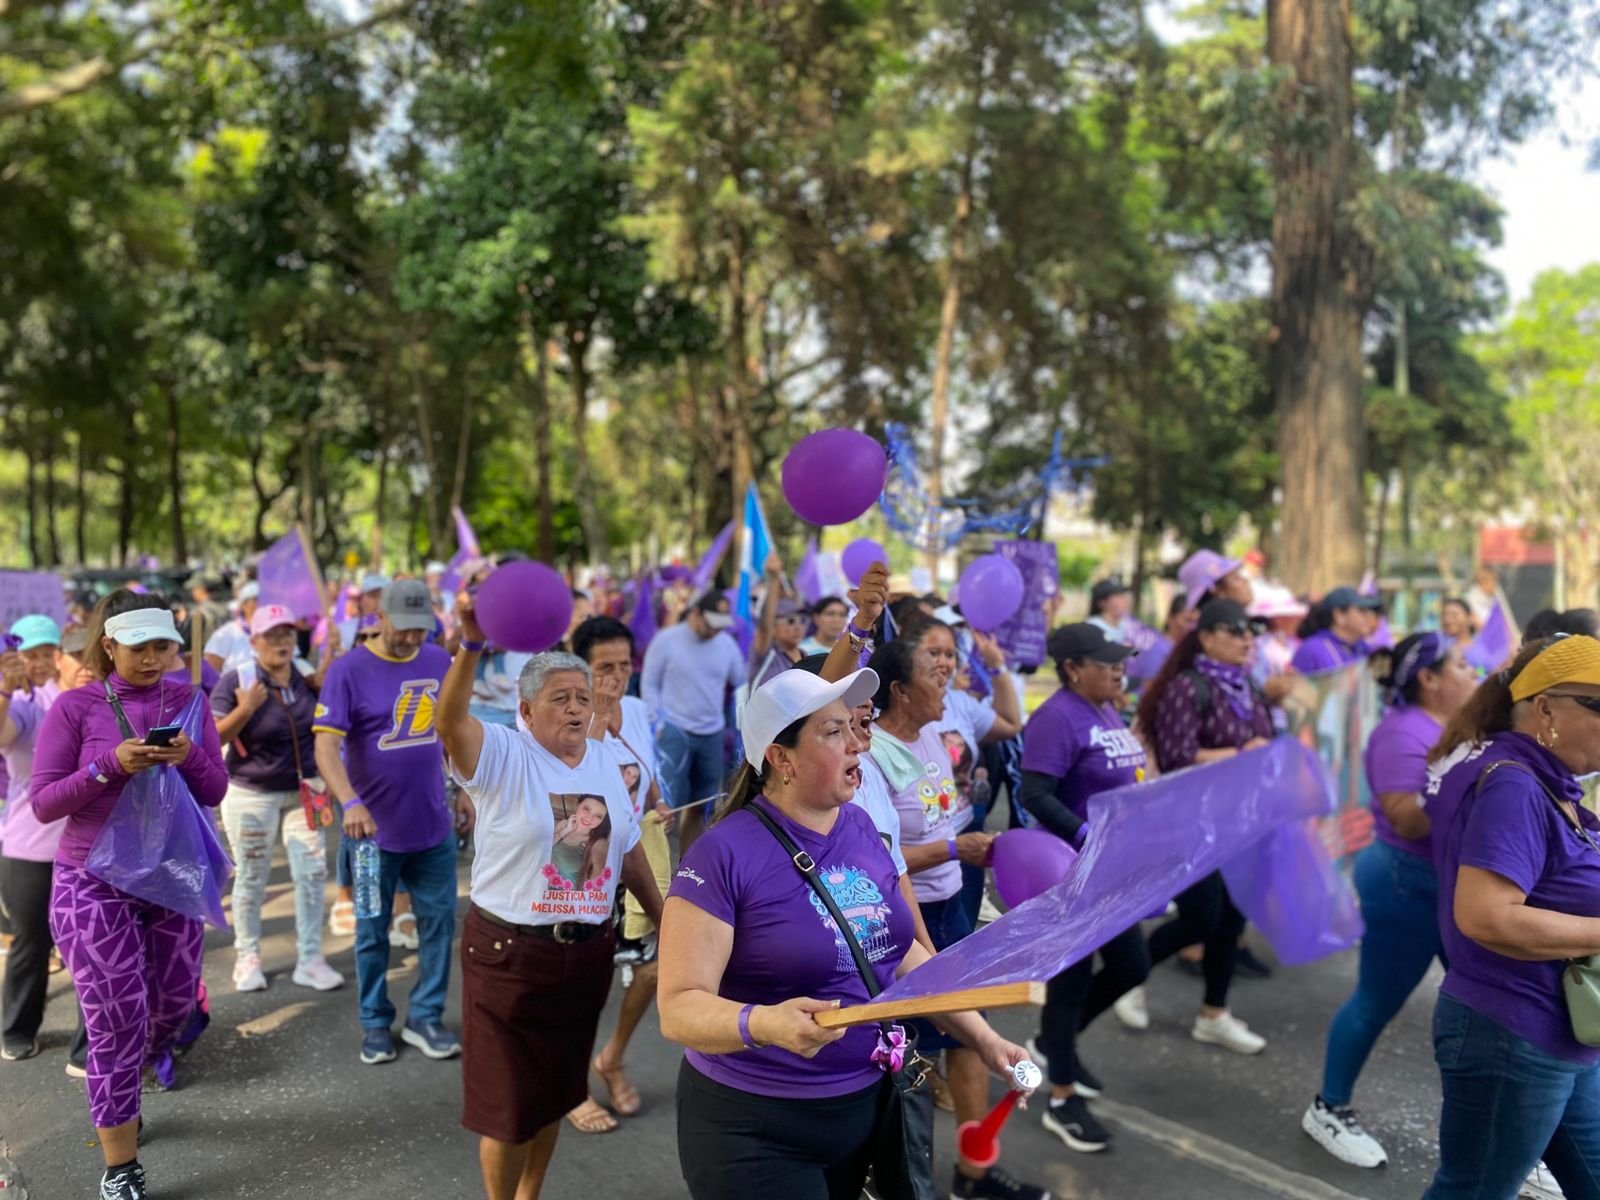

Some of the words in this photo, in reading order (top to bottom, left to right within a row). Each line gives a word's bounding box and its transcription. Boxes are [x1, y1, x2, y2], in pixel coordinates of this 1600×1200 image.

[542, 890, 585, 901] ¡JUSTICIA
[589, 891, 608, 902] PARA
[531, 902, 576, 914] MELISSA
[578, 904, 610, 915] PALACIOS
